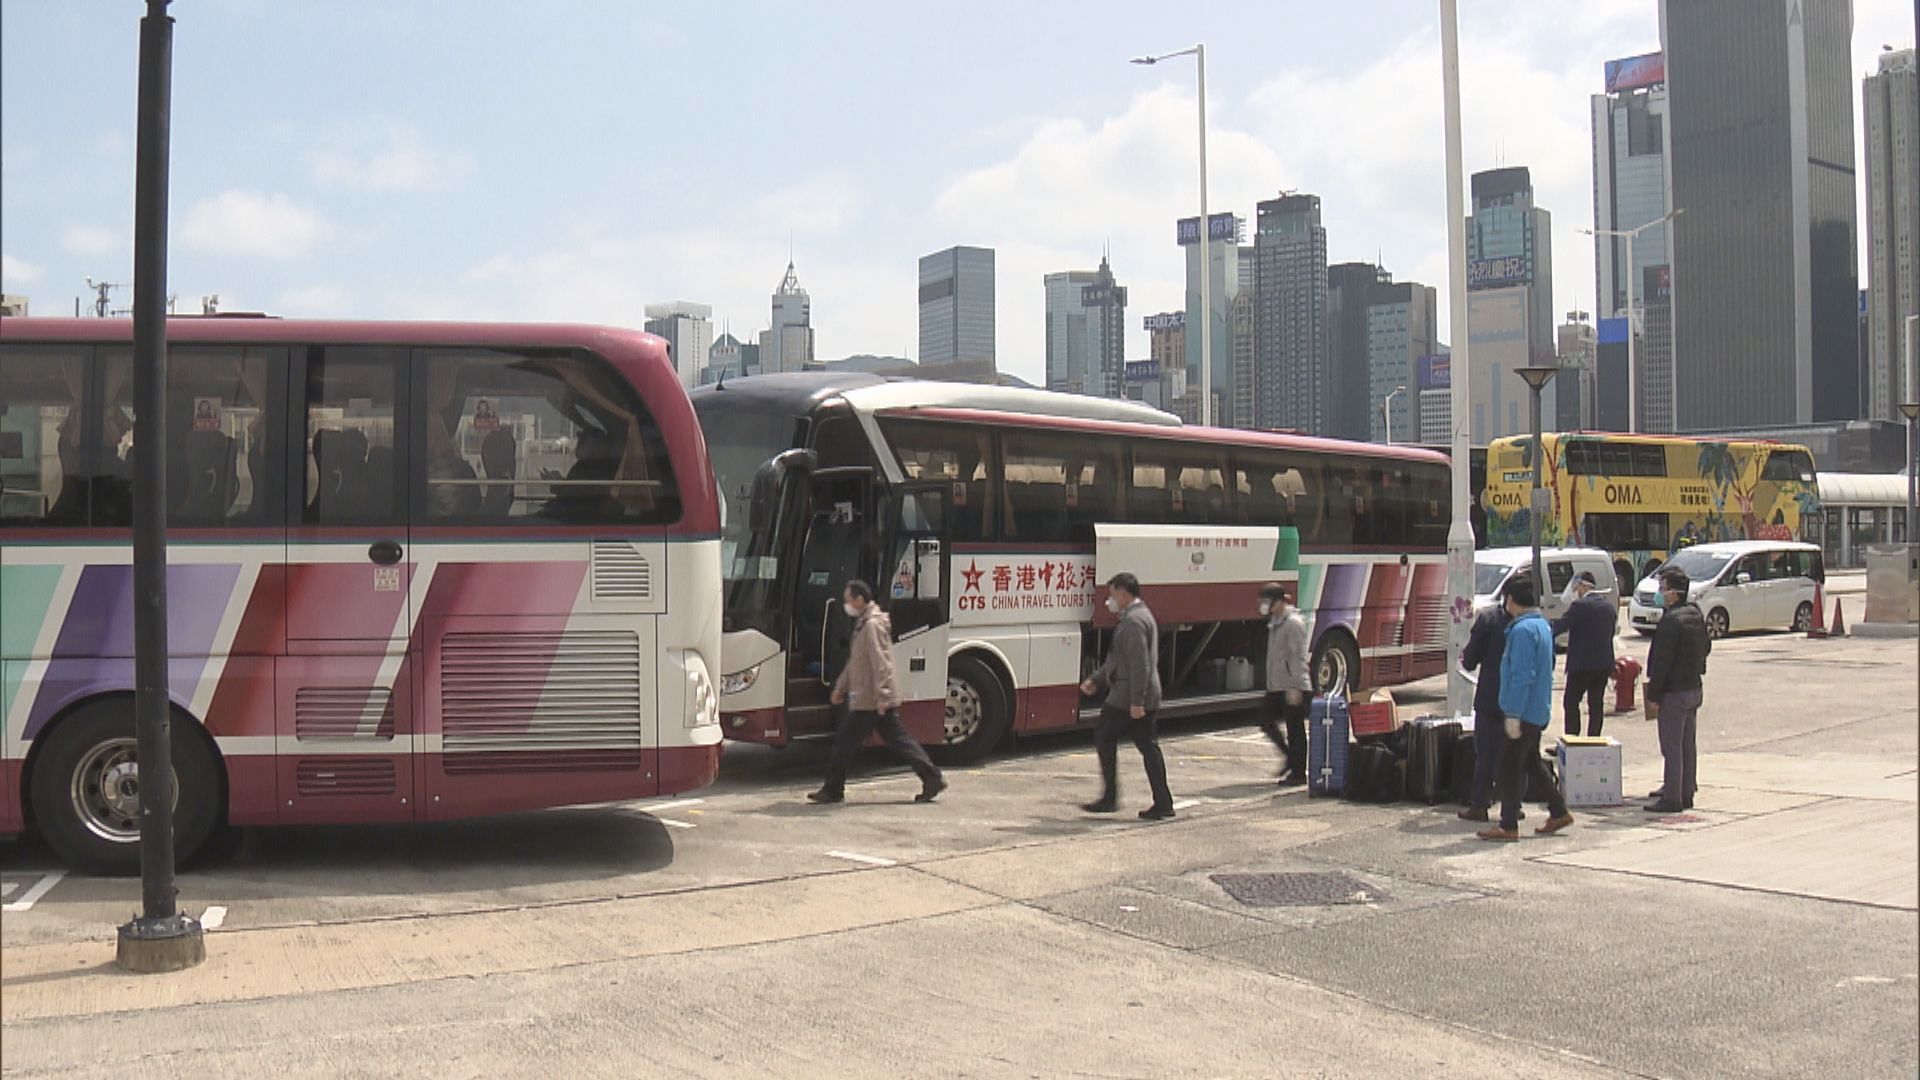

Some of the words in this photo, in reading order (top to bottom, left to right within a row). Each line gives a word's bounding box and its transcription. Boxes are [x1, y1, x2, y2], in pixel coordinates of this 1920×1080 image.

[1492, 492, 1522, 506] OMA
[1604, 484, 1642, 505] OMA
[958, 596, 986, 610] CTS
[991, 595, 1020, 610] CHINA
[1021, 594, 1054, 609] TRAVEL
[1056, 594, 1084, 608] TOURS
